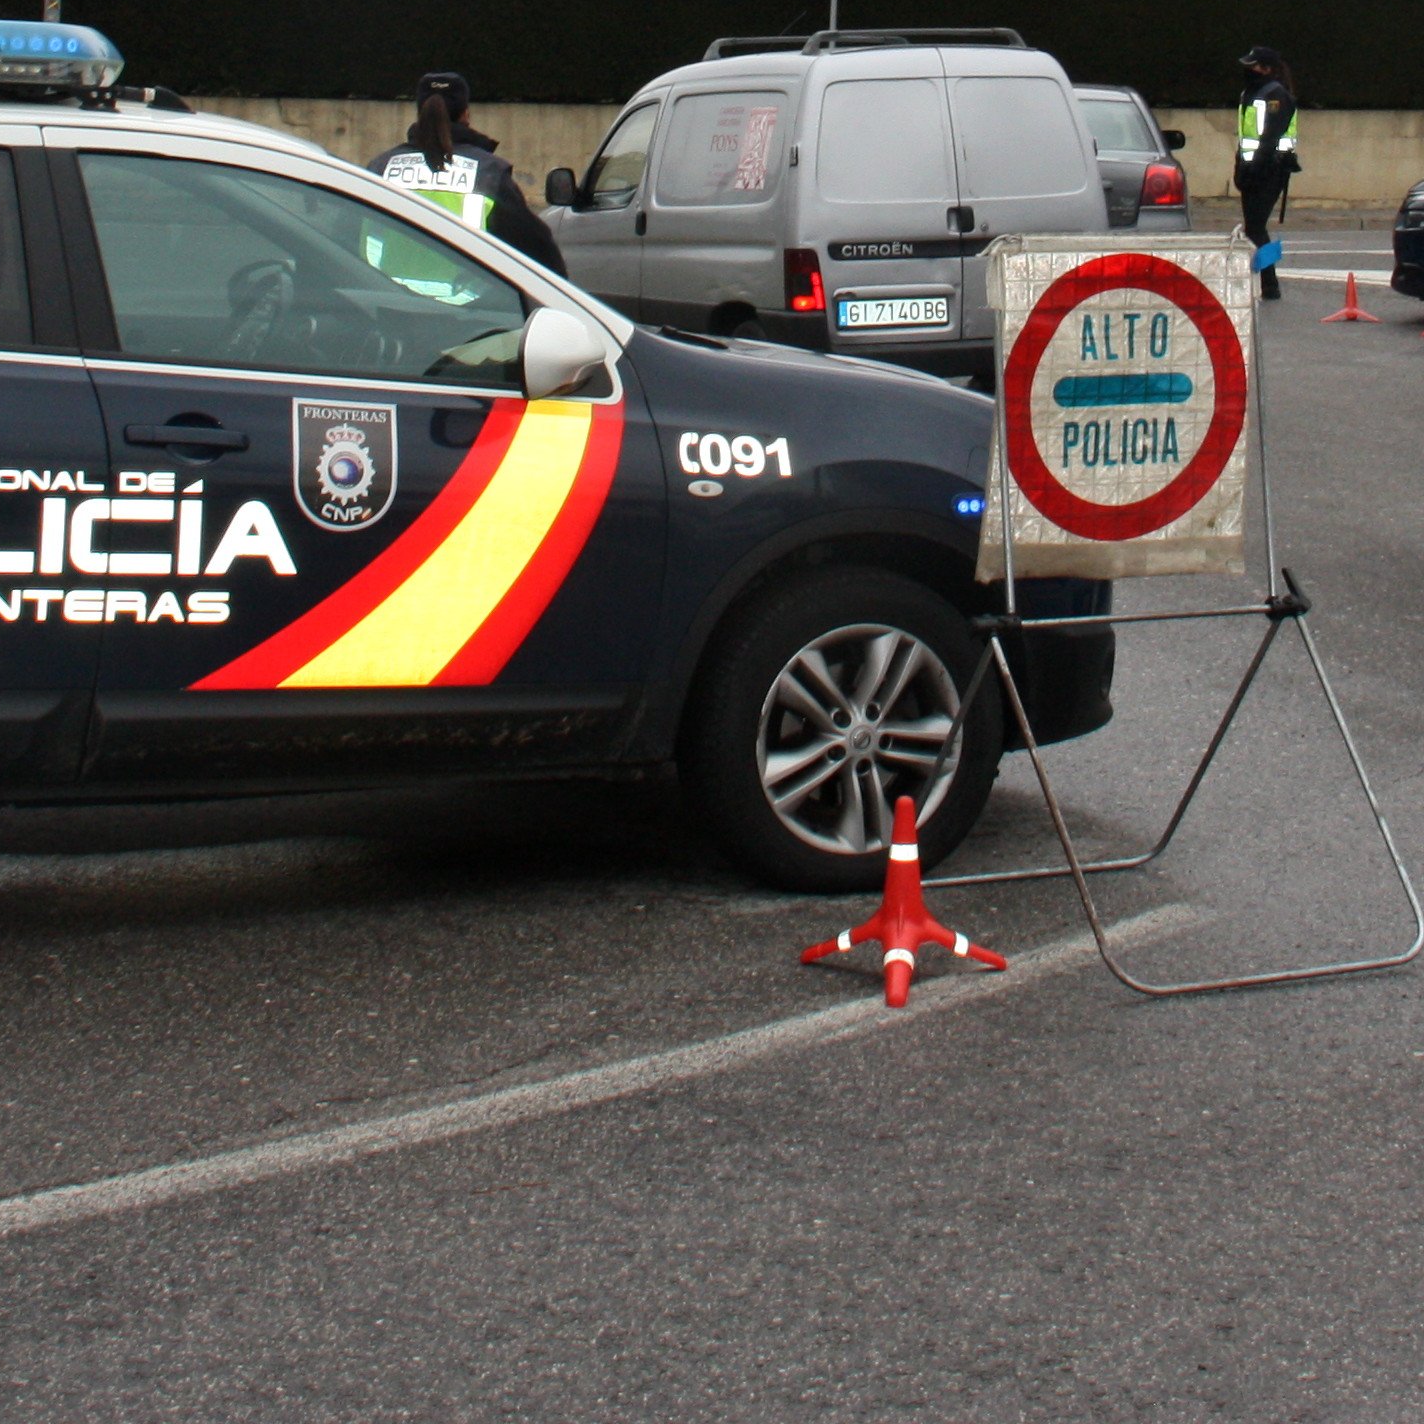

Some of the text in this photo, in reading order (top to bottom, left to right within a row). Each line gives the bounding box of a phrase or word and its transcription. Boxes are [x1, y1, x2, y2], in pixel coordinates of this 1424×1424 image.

[387, 167, 468, 187] POLICIA
[841, 241, 914, 257] CITROËN
[1080, 311, 1170, 362] ALTO
[302, 406, 388, 424] FRONTERAS
[1062, 416, 1180, 469] POLICIA
[117, 471, 176, 494] DE
[320, 502, 364, 522] CNP
